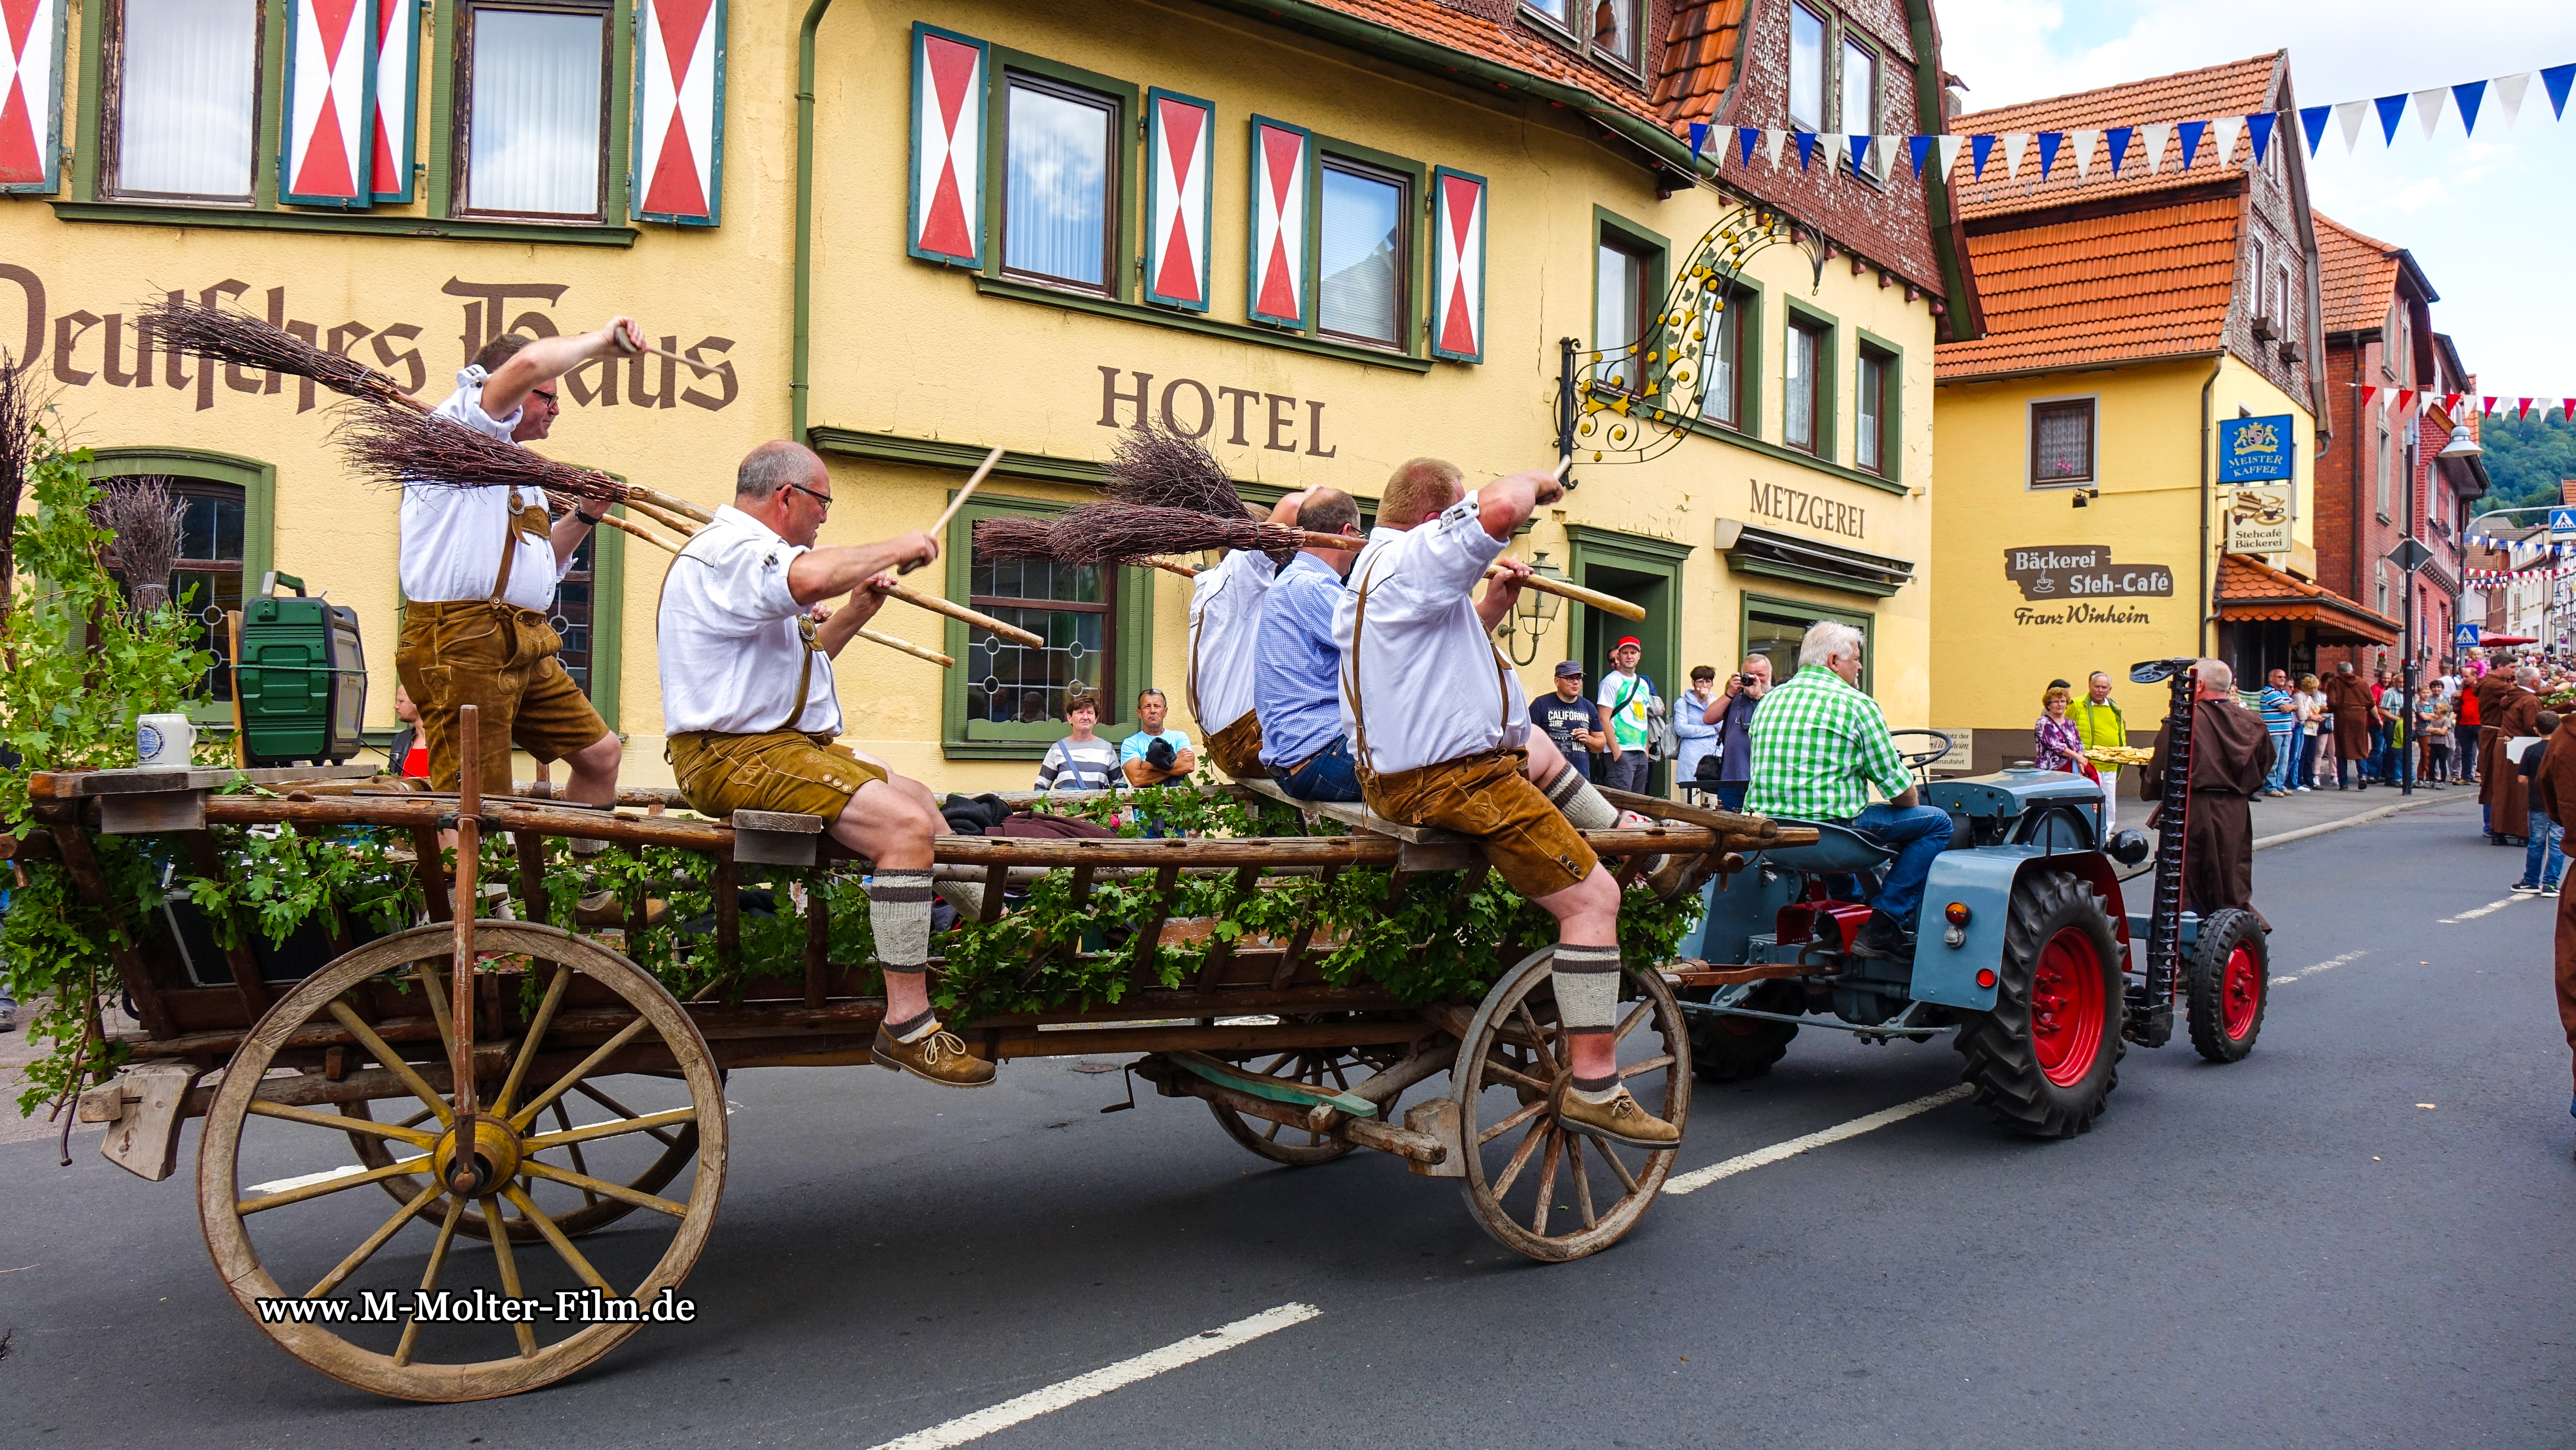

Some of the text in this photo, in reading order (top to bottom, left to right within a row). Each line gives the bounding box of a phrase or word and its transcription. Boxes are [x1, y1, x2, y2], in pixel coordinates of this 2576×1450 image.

[1096, 365, 1336, 459] HOTEL
[2228, 454, 2283, 468] MEISTER
[2233, 465, 2278, 477] KAFFEE
[1750, 478, 1864, 539] METZGEREI
[2235, 528, 2282, 539] Stehcafé
[2235, 538, 2282, 548] Bäckerei
[2015, 550, 2096, 571] Bäckerei
[2069, 572, 2168, 594] Steh-Café
[2014, 602, 2150, 626] Franz Winheim
[1548, 710, 1589, 723] CALIFORNIA
